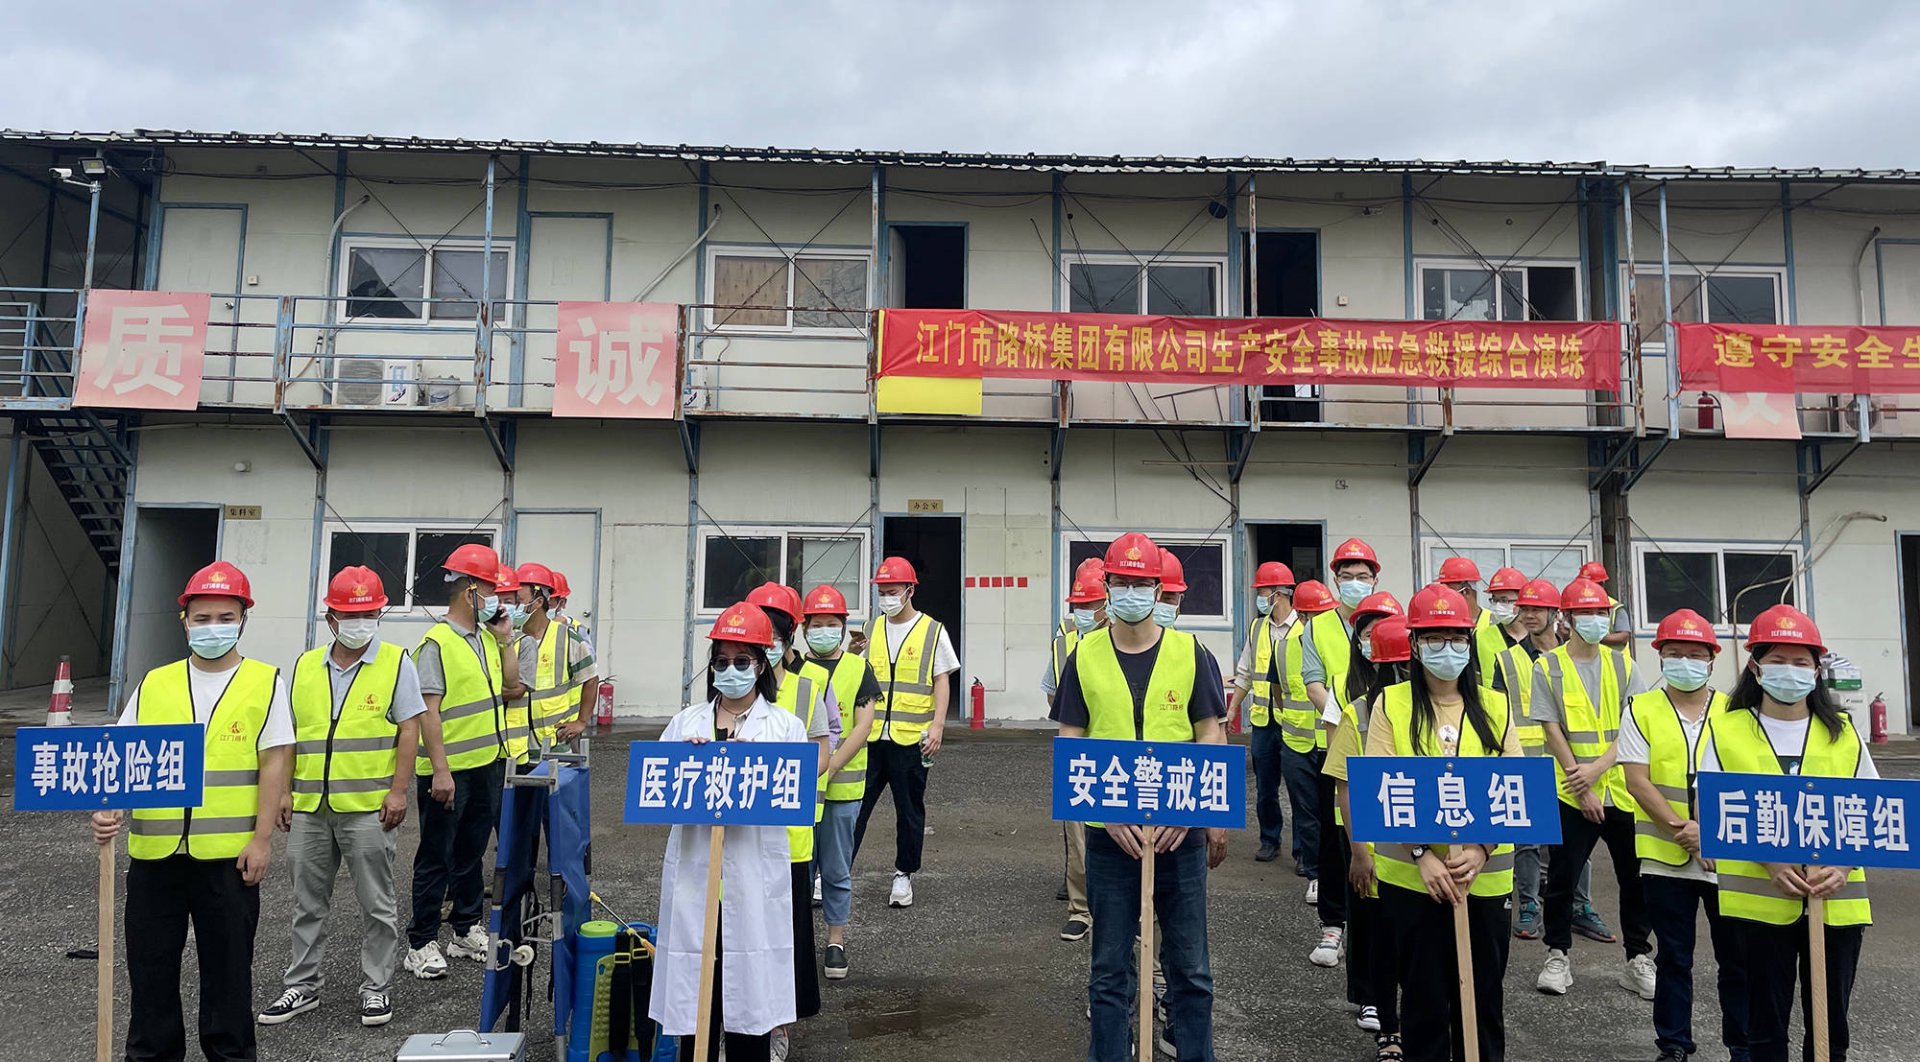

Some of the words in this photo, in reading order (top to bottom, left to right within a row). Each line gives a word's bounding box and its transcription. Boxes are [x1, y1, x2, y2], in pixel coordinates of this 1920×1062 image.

[93, 304, 194, 396] 质
[569, 314, 663, 406] 诚
[916, 320, 1585, 379] 江门市路桥集团有限公司生产安全事故应急救援综合演练
[31, 739, 186, 796] 事故抢险组
[639, 755, 802, 810] 医疗救护组
[1068, 753, 1230, 812] 安全警戒组
[1377, 771, 1532, 828] 信息组
[1717, 789, 1910, 851] 后勤保障组
